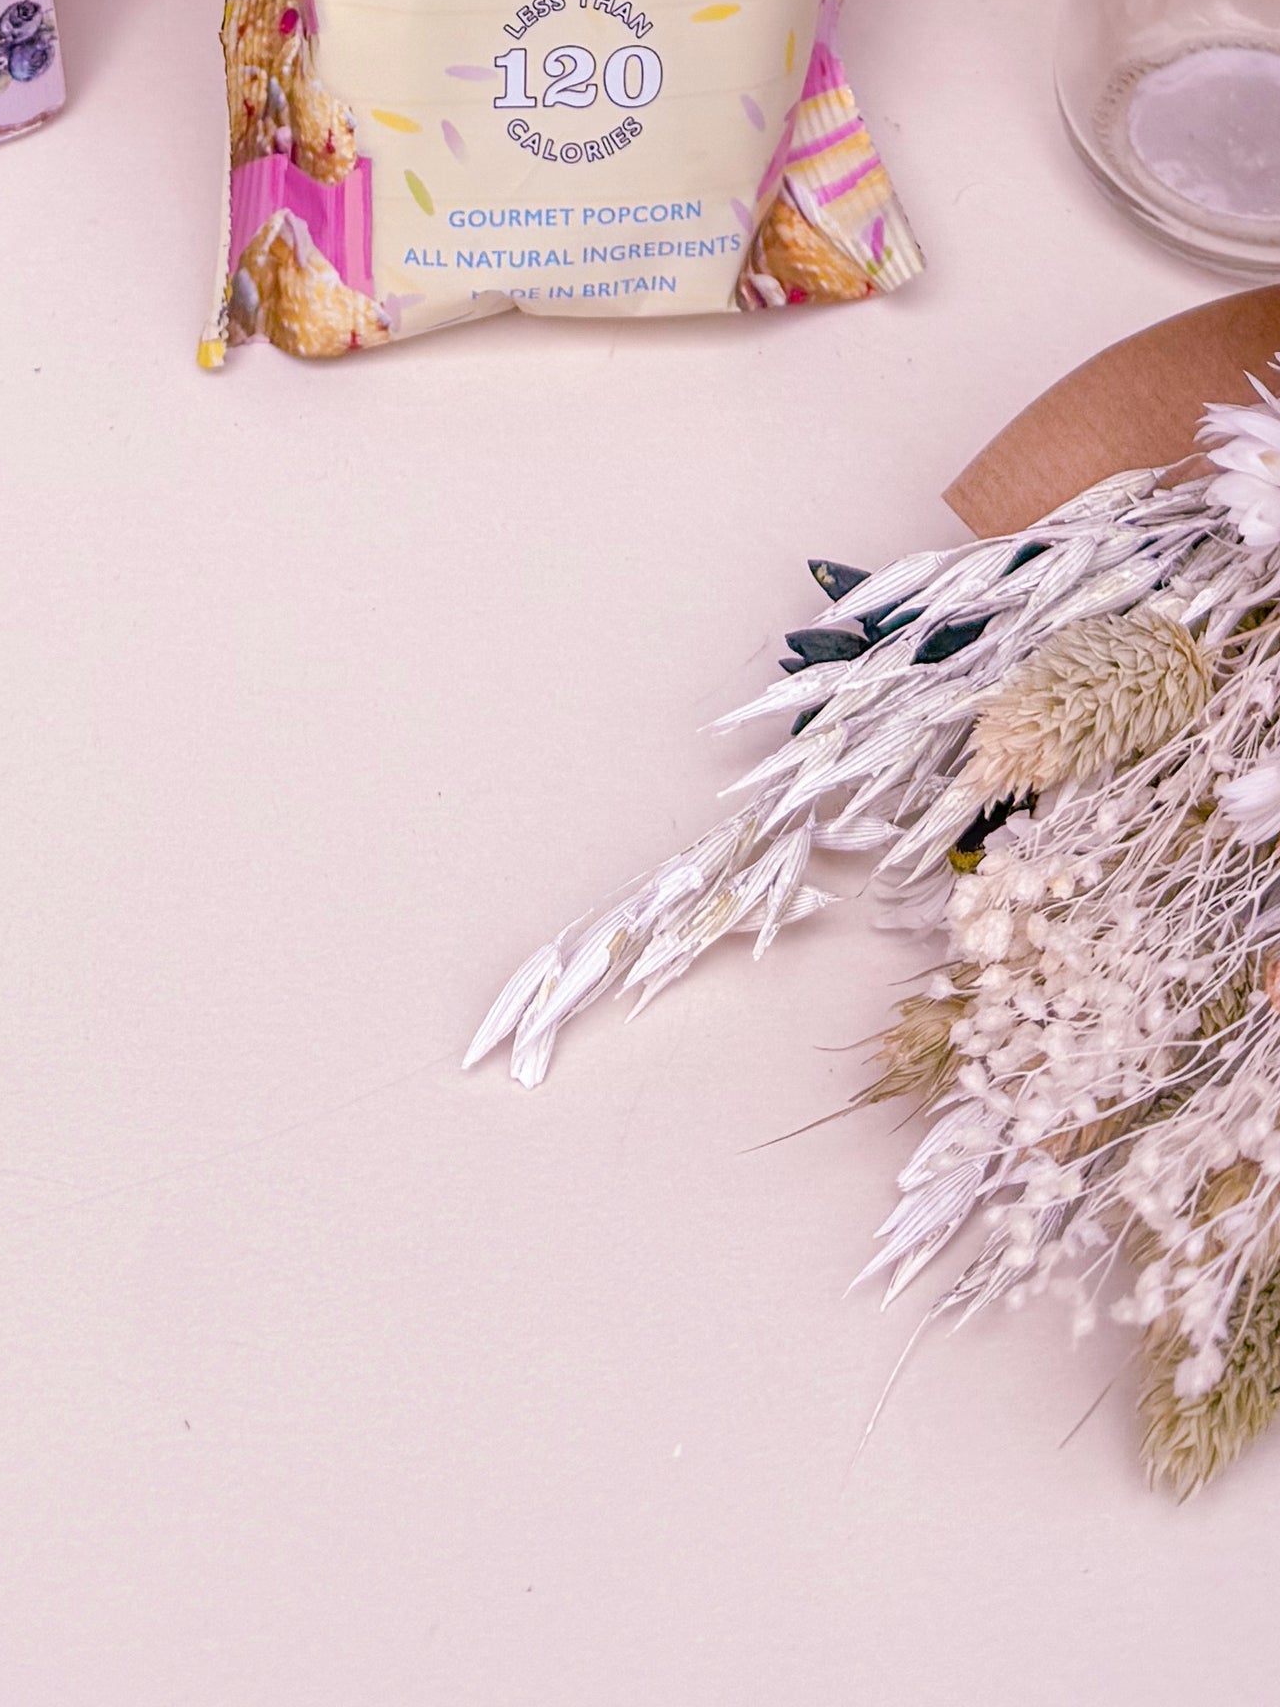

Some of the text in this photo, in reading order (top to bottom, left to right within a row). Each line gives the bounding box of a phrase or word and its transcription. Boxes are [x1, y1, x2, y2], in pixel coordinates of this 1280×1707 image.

[493, 44, 663, 109] 120
[507, 116, 643, 164] CALORIES
[448, 200, 702, 228] GOURMET POPCORN
[404, 233, 742, 269] ALL NATURAL INGREDIENTS
[549, 285, 574, 299] IN
[582, 275, 677, 299] BRITAIN
